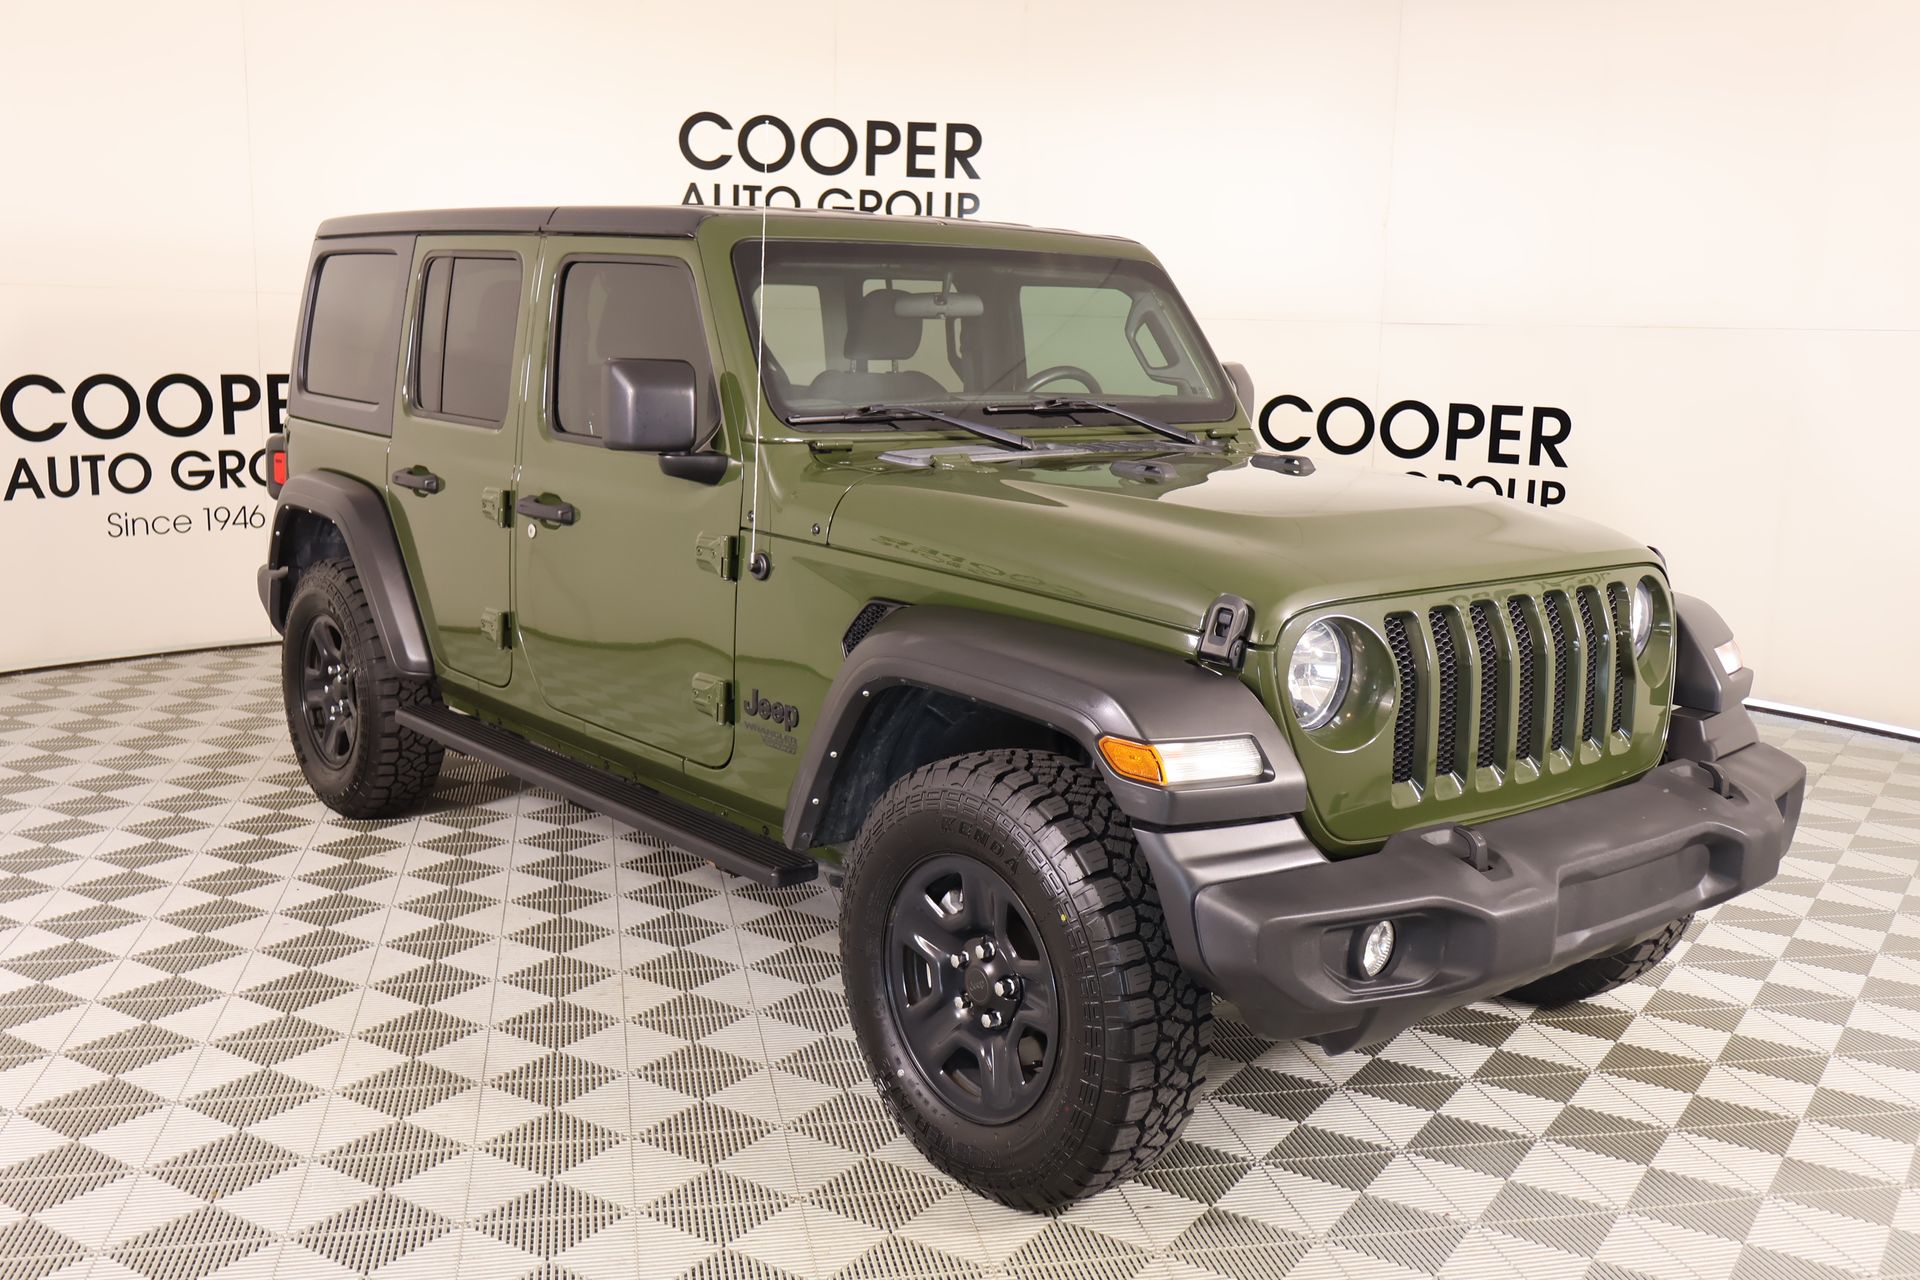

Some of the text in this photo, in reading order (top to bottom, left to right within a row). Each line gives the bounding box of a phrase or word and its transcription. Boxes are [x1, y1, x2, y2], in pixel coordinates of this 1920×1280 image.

[679, 111, 982, 179] COOPER
[0, 373, 290, 442] COOPE
[1258, 394, 1572, 468] COOPER
[4, 452, 152, 501] AUTO
[107, 505, 266, 538] Since 1946
[743, 688, 799, 732] Jeep
[941, 816, 1020, 875] KENDA
